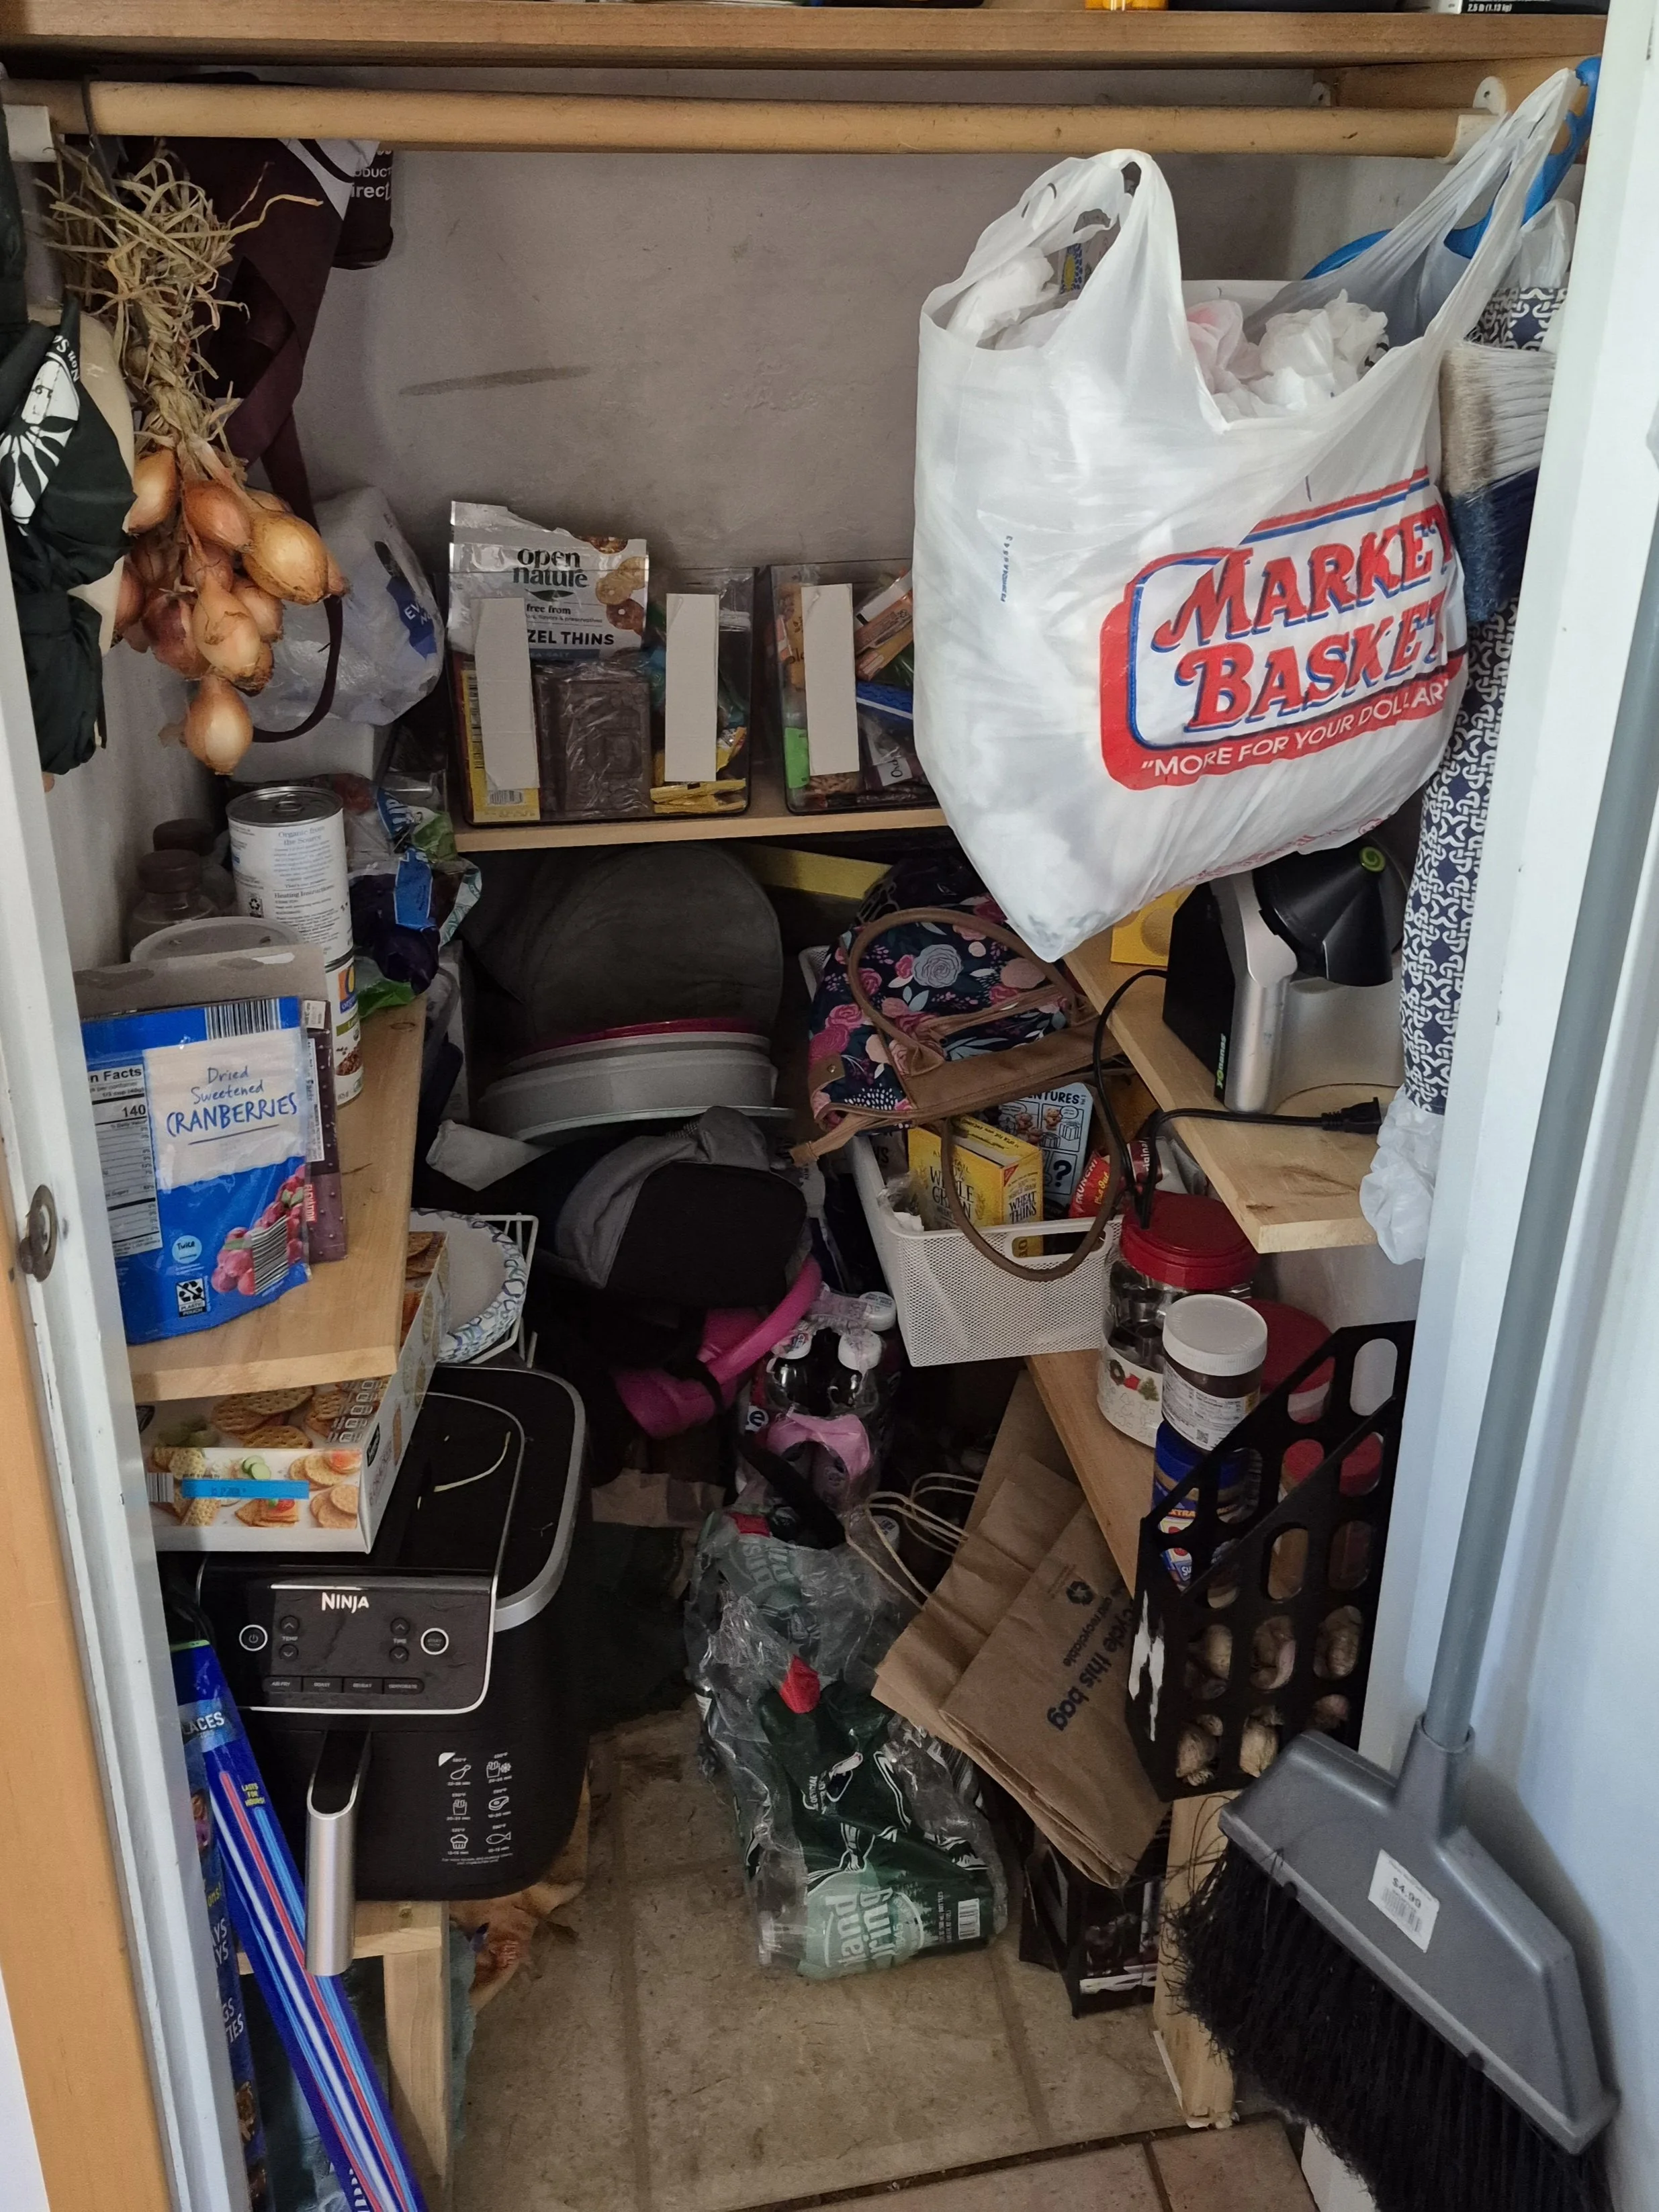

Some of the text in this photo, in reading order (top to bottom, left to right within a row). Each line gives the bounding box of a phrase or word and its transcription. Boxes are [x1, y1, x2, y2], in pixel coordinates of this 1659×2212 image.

[517, 548, 581, 569] open
[512, 566, 588, 588] nature
[526, 604, 572, 615] free from
[561, 631, 615, 645] THINS
[1238, 738, 1289, 763] FOR
[1295, 716, 1353, 746] YOUR
[278, 830, 309, 839] Organic
[297, 835, 322, 845] Source
[103, 1068, 142, 1082] Facts
[208, 1066, 249, 1085] Dried
[191, 1079, 265, 1105] Sweetened
[122, 1103, 146, 1118] 140
[167, 1091, 298, 1138] CRANBERRIES
[1009, 1191, 1037, 1213] WHEAT
[1010, 1203, 1037, 1225] THINS
[322, 1592, 369, 1614] NINJA
[1079, 1652, 1112, 1689] this
[1046, 1686, 1089, 1732] bag
[242, 1782, 259, 1792] LASTS
